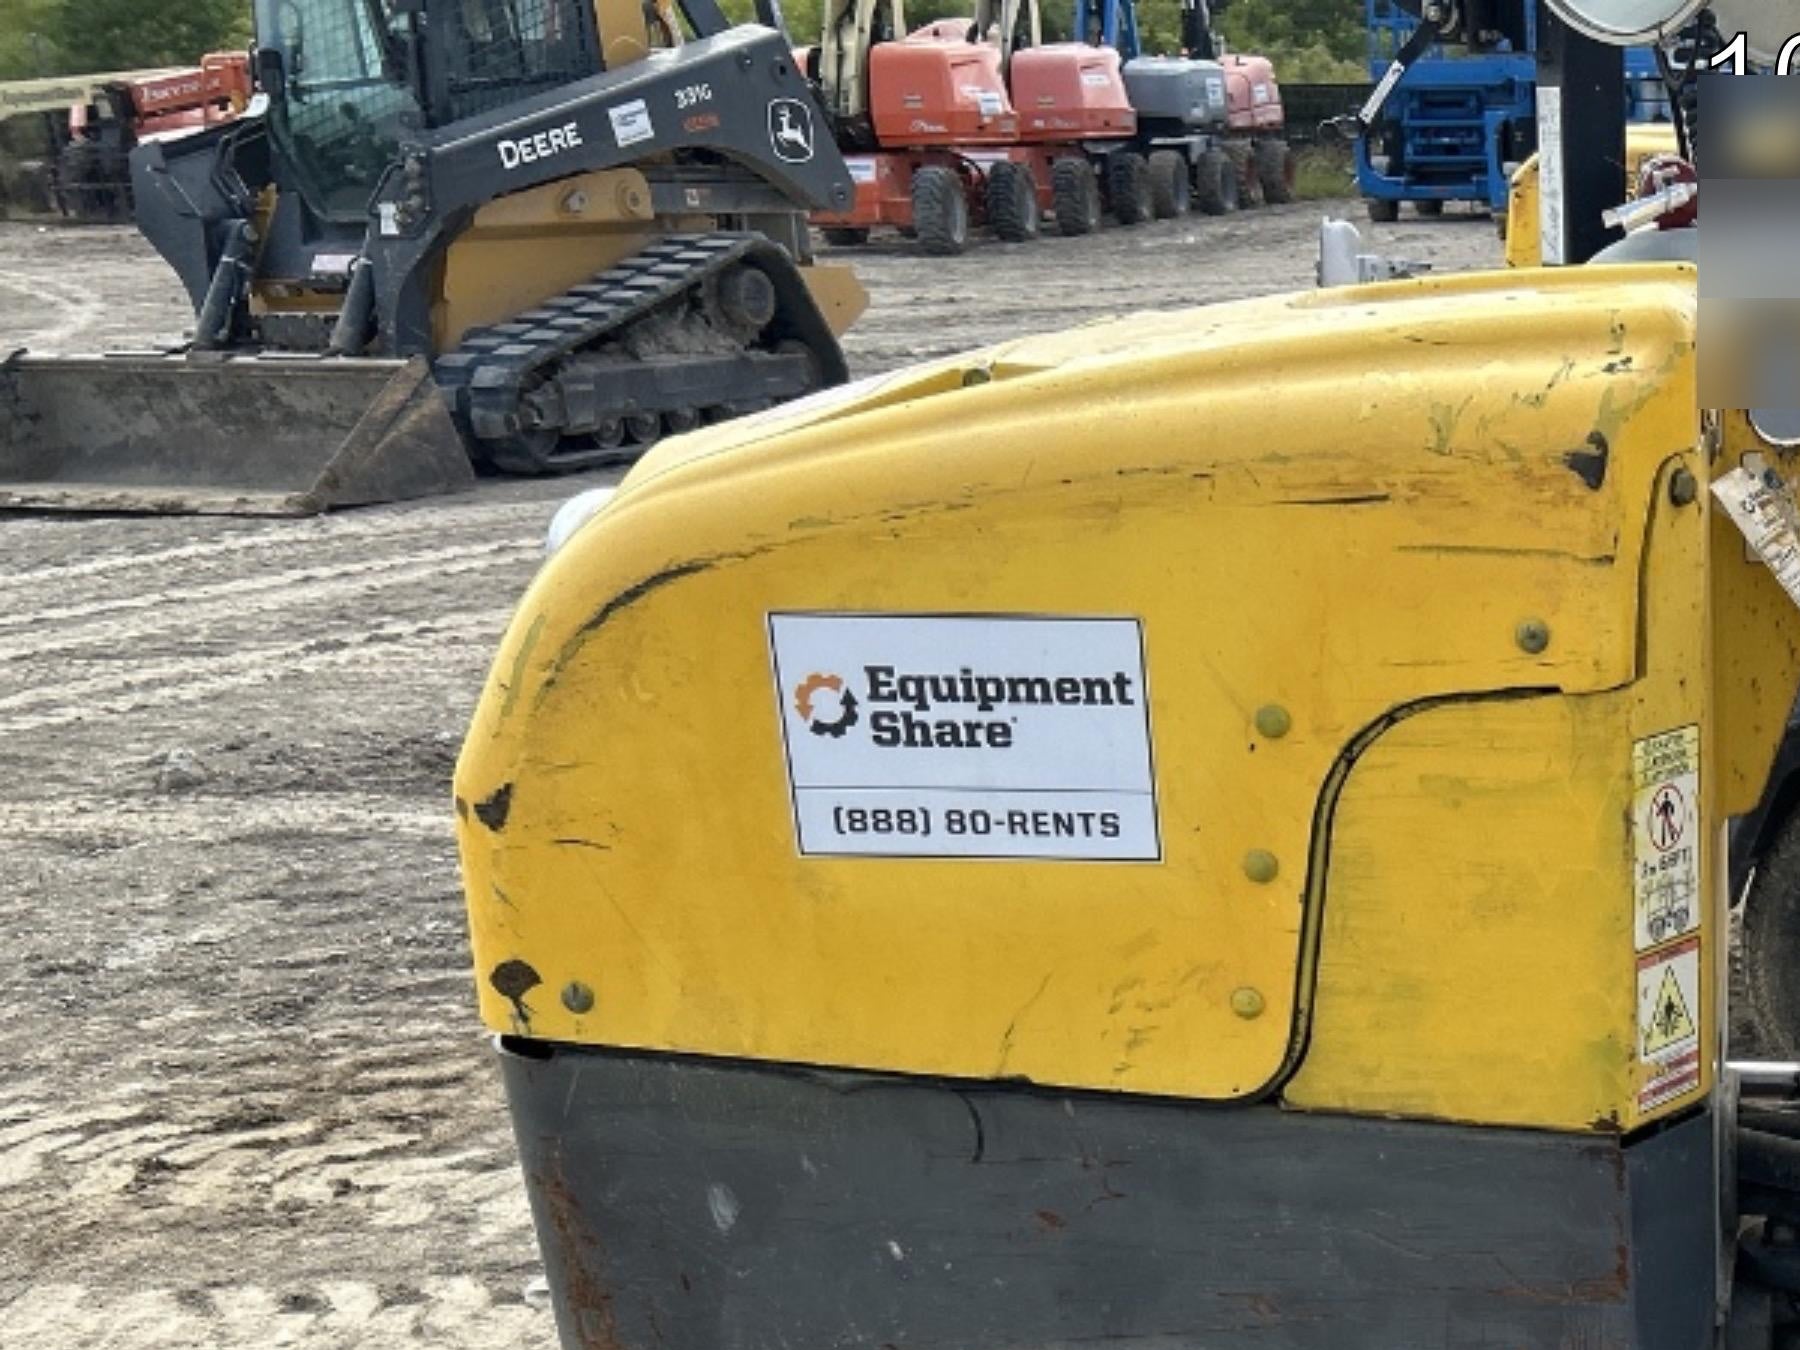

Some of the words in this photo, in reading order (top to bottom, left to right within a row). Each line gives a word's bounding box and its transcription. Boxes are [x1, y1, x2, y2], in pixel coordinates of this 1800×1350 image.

[497, 121, 583, 169] DEERE
[864, 665, 1135, 711] Equipment
[869, 711, 1013, 748] Share
[833, 806, 931, 837] (888)
[944, 808, 1121, 838] 80-RENTS
